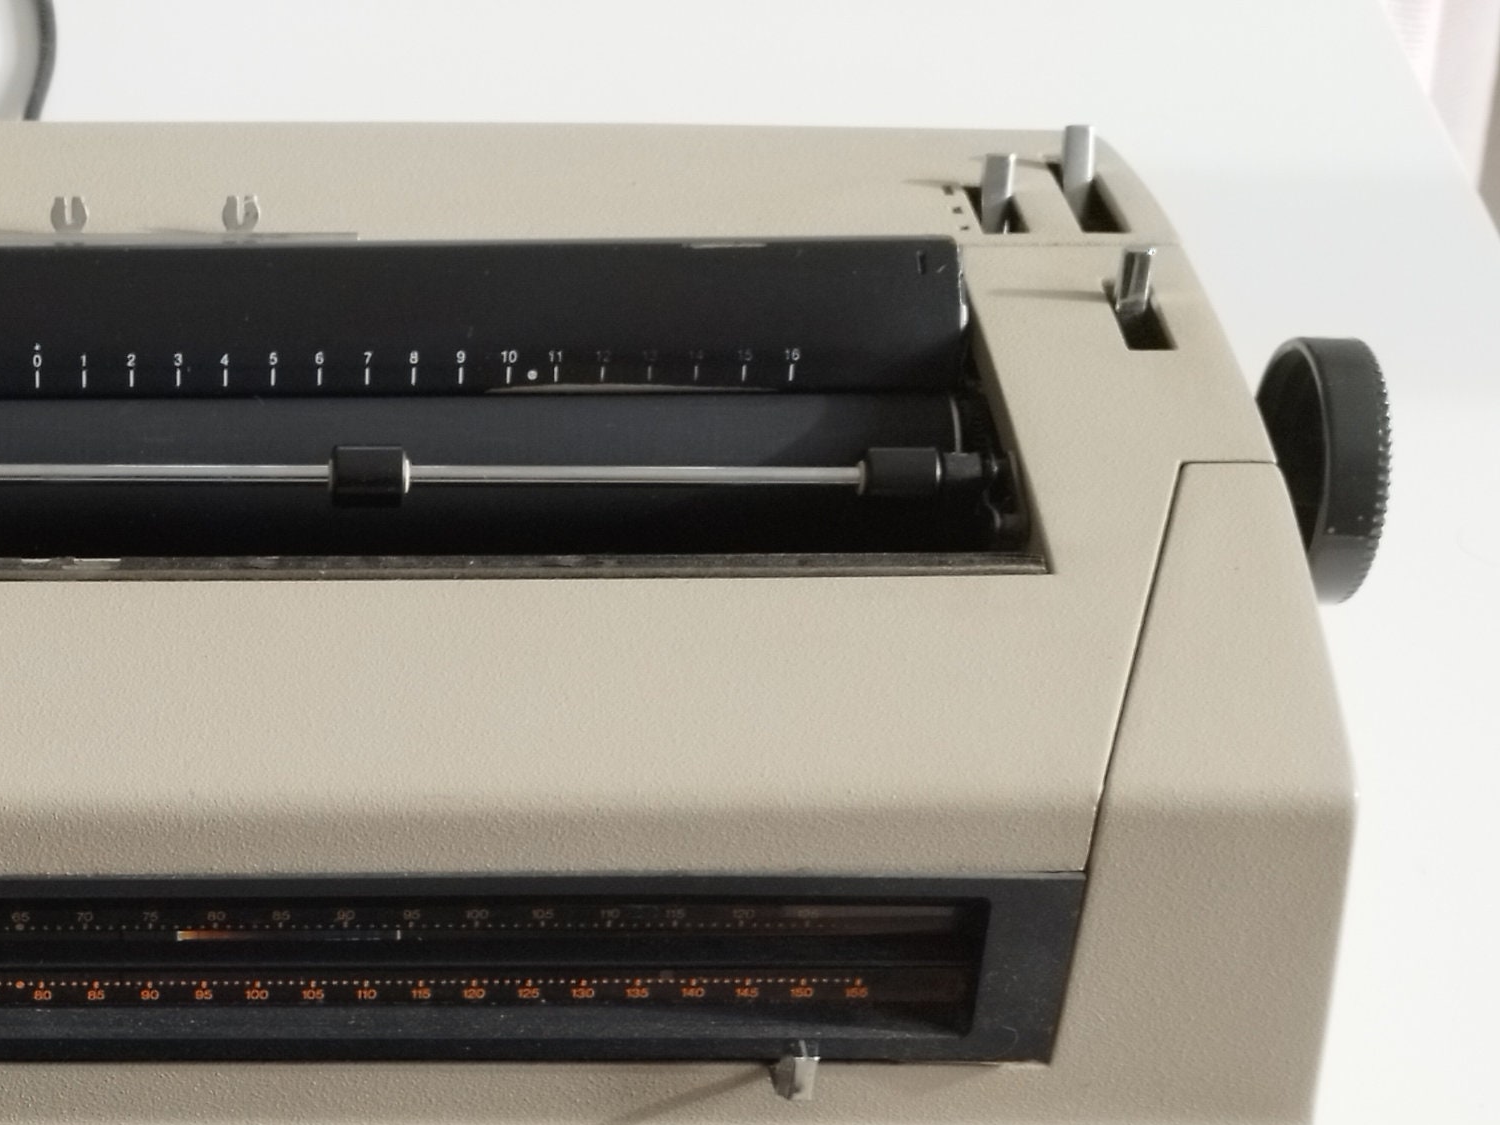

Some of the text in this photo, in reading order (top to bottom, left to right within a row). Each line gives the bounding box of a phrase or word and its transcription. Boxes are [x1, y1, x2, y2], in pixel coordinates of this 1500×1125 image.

[32, 354, 43, 367] 0
[80, 354, 87, 366] 1
[126, 353, 136, 366] 2
[174, 352, 183, 365] 3
[219, 353, 229, 366] 4
[269, 351, 278, 364] 5
[314, 351, 325, 364] 6
[363, 351, 373, 364] 7
[409, 350, 419, 363] 8
[456, 350, 466, 363] 9
[500, 349, 518, 363] 10
[548, 350, 563, 362] 11
[785, 348, 801, 361] 16
[33, 989, 52, 1001] 80
[87, 988, 105, 1001] 85
[140, 988, 160, 1001] 90
[194, 988, 213, 1000] 95
[245, 988, 269, 1000] 100
[301, 988, 325, 1000] 105
[356, 988, 378, 1000] 110
[410, 988, 432, 1000] 115
[462, 988, 486, 999] 120
[517, 988, 540, 999] 125
[571, 988, 595, 999] 130
[625, 988, 649, 998] 135
[681, 987, 705, 998] 140
[735, 988, 759, 998] 145
[789, 987, 814, 998] 150
[845, 987, 868, 998] 155
